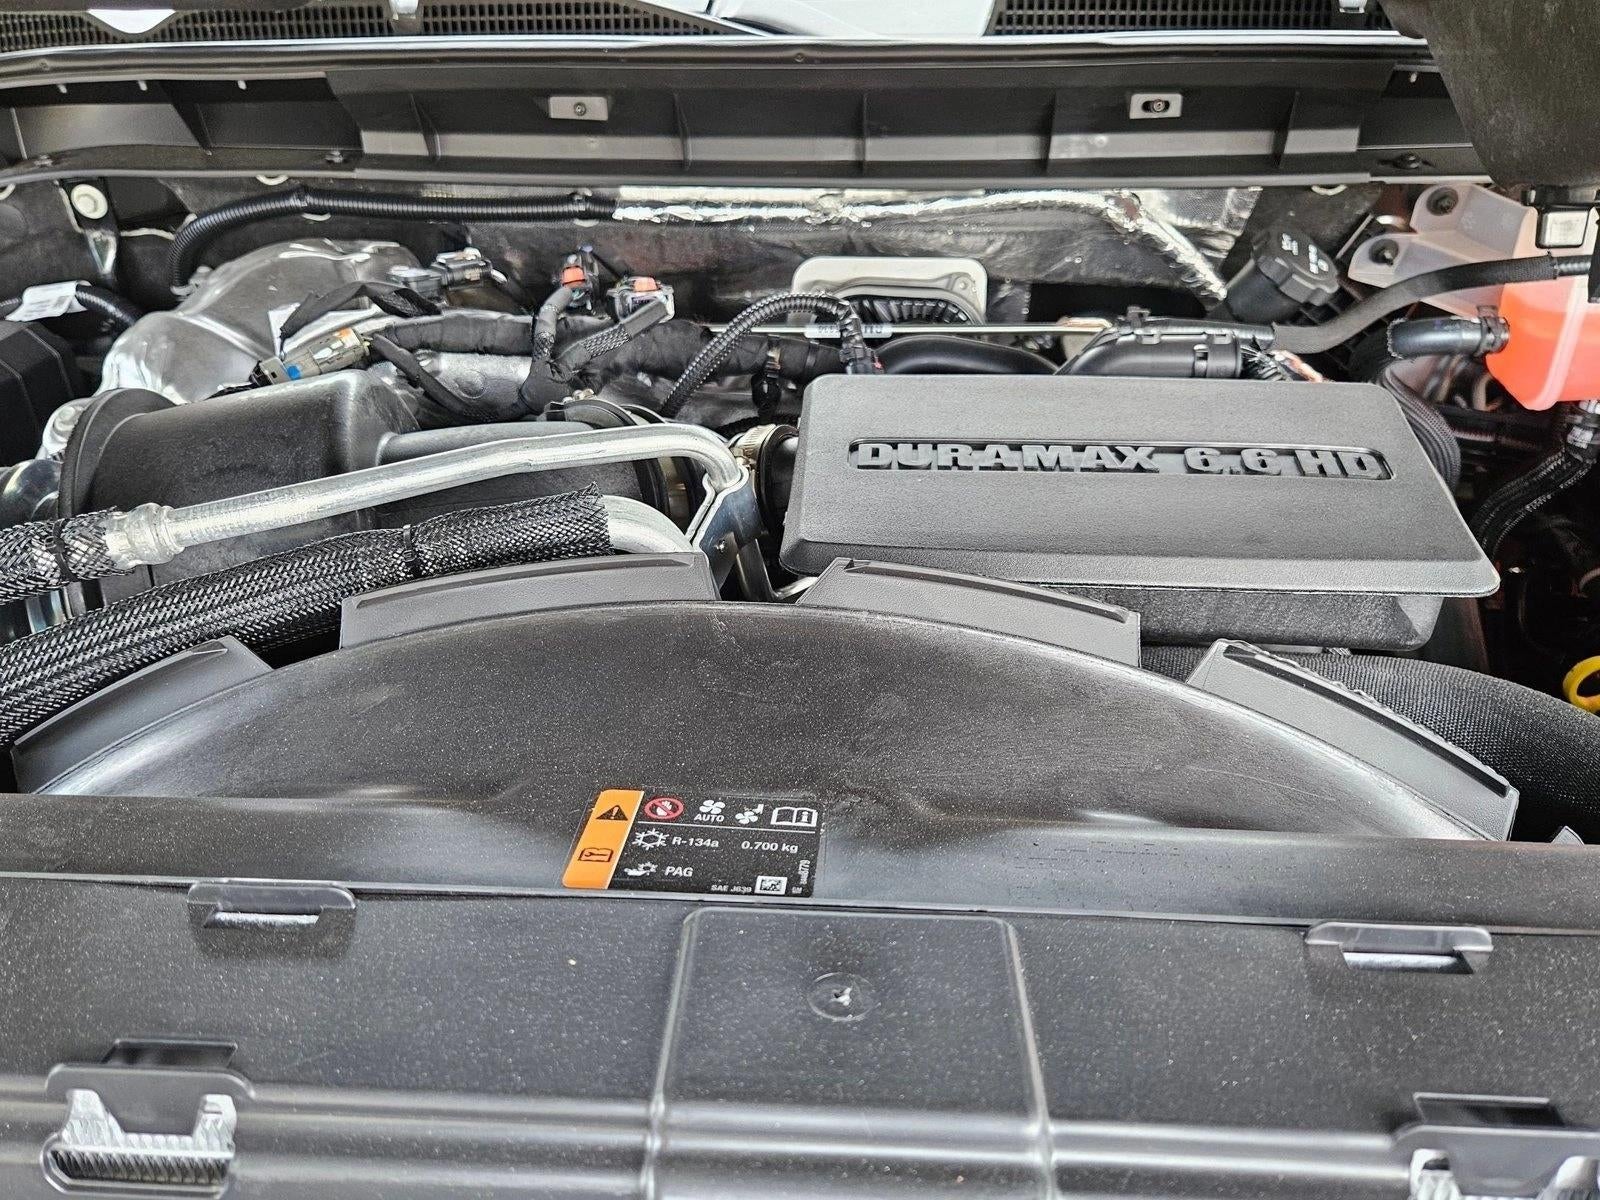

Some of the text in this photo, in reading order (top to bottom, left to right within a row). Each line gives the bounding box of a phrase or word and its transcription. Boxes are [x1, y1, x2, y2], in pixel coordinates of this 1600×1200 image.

[857, 443, 1388, 480] DURAMAX 6.6 HD
[693, 813, 725, 823] AUTO
[671, 836, 799, 854] R-134a 0.700 kg
[664, 866, 694, 877] PAG
[730, 885, 752, 894] J639
